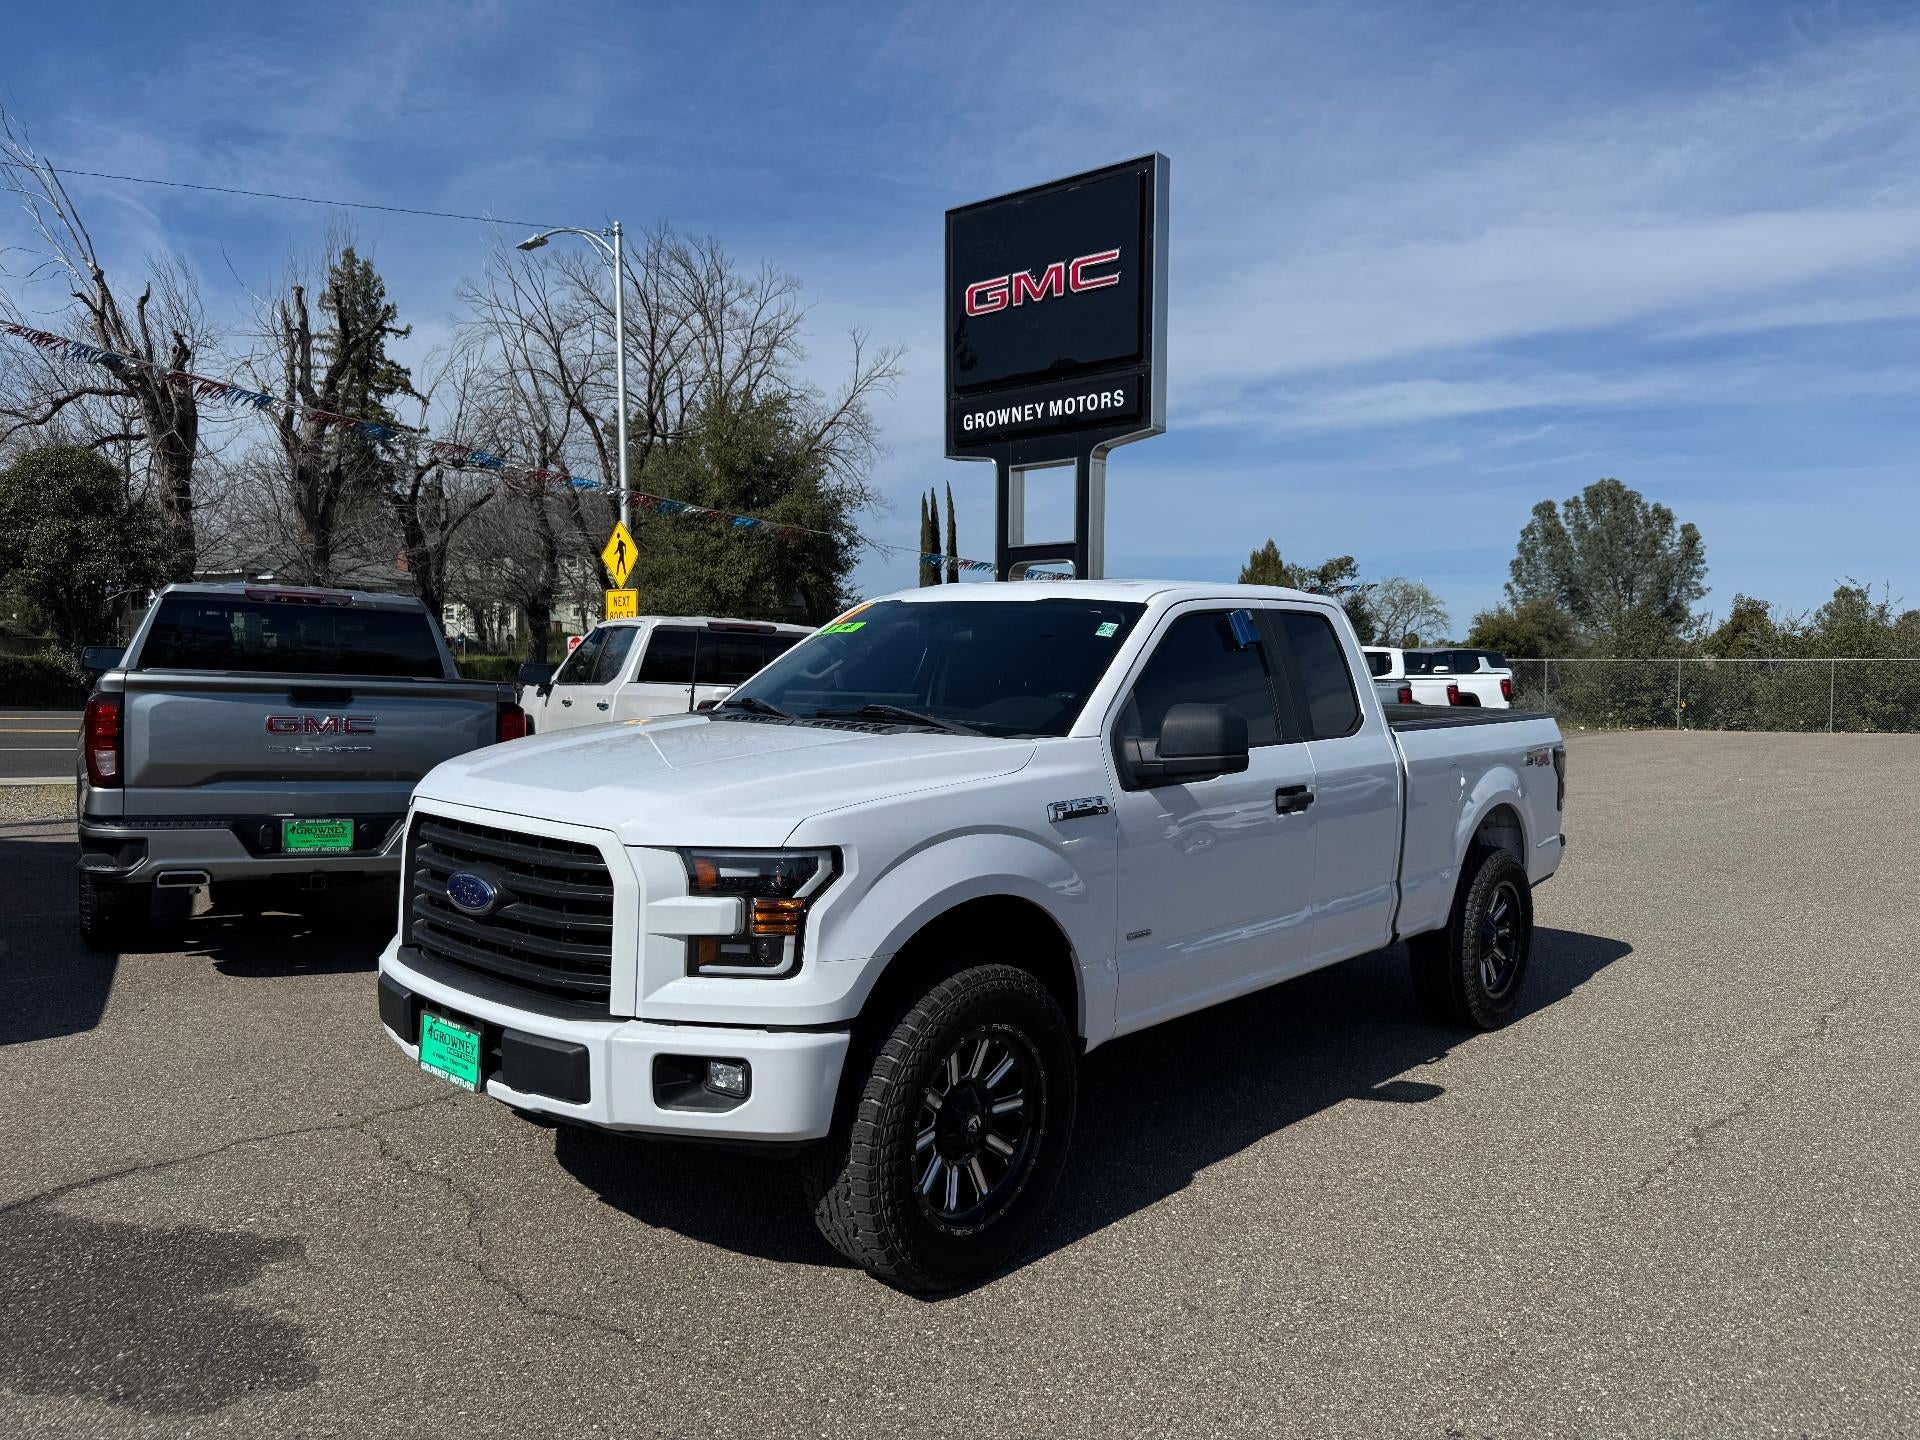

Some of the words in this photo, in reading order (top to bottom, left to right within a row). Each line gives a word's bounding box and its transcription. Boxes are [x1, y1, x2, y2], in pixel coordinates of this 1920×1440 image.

[966, 249, 1121, 316] GMC
[963, 402, 1044, 431] GROWNEY
[1049, 389, 1125, 417] MOTORS
[613, 596, 630, 607] NEXT
[265, 715, 376, 734] GMC
[296, 826, 347, 834] GROWNEY
[434, 1029, 476, 1056] GROWNEY
[421, 1061, 449, 1080] GROWNEY
[450, 1074, 475, 1092] MOTORS
